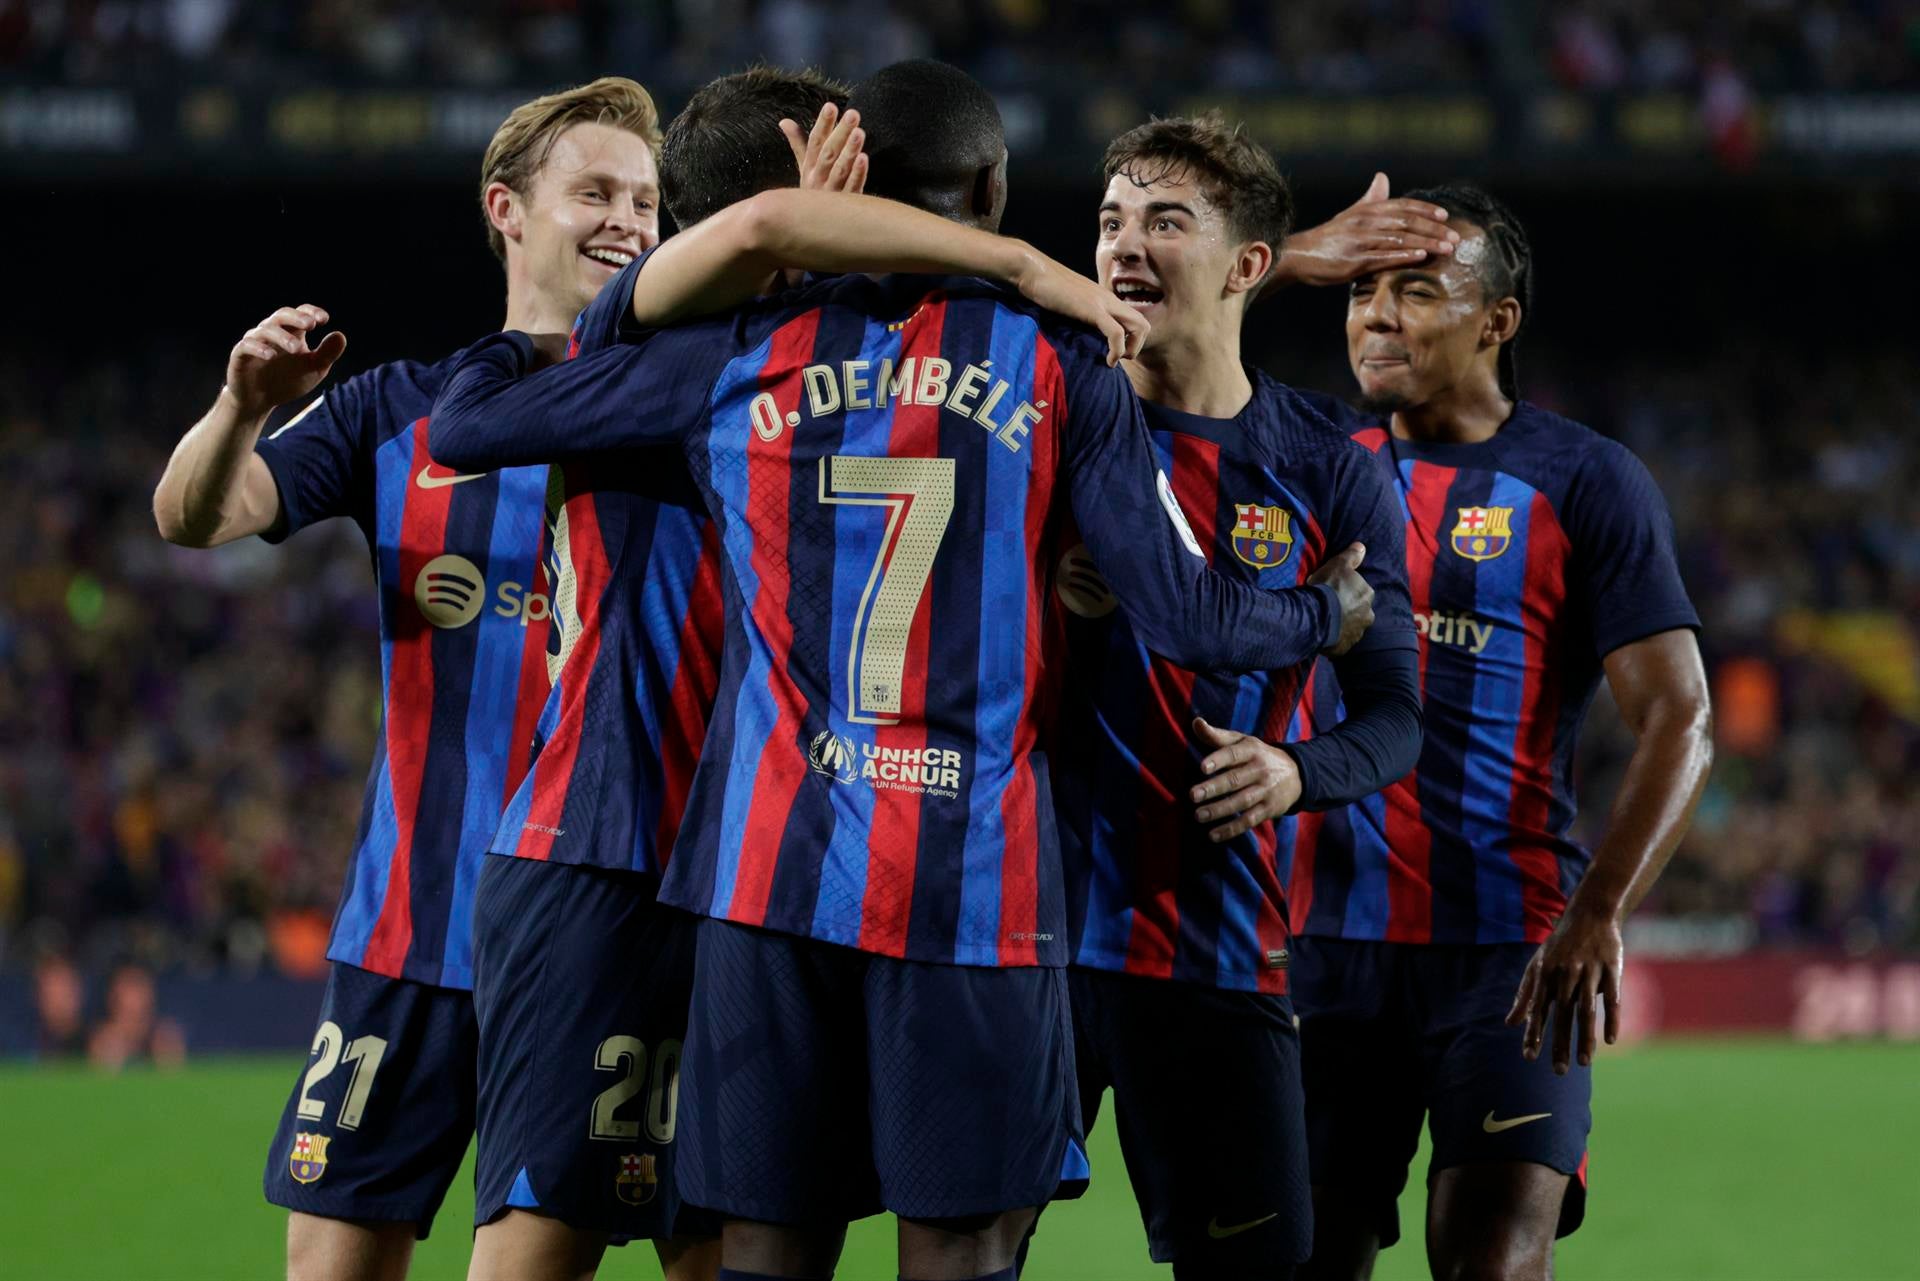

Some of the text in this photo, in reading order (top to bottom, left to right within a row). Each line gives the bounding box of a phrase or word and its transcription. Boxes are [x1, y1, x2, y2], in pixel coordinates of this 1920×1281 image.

[749, 356, 1049, 454] O. DEMBÉLÉ
[818, 455, 956, 726] 7
[861, 759, 961, 789] ACNUR
[862, 742, 962, 769] UNHCR
[876, 780, 890, 789] UN
[890, 782, 926, 794] Refugee
[926, 786, 959, 800] Agency
[296, 1020, 388, 1132] 21
[589, 1034, 680, 1144] 20
